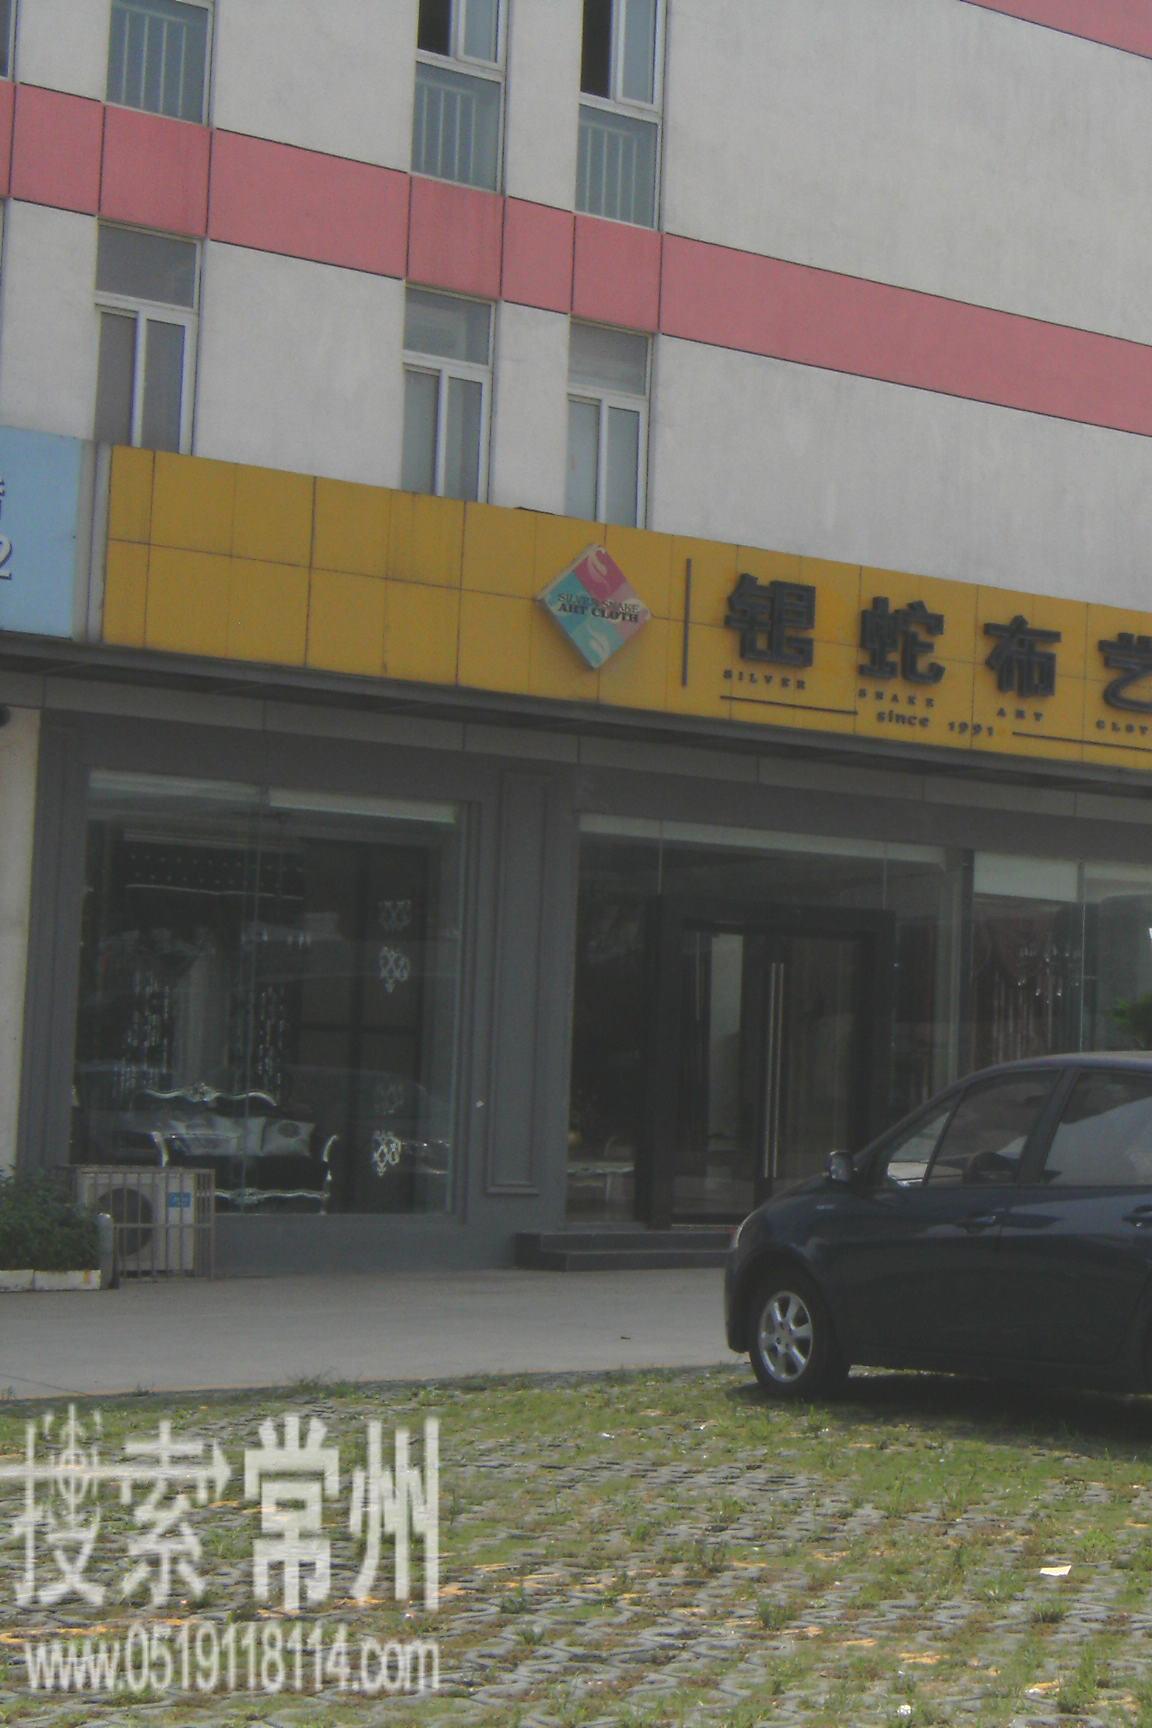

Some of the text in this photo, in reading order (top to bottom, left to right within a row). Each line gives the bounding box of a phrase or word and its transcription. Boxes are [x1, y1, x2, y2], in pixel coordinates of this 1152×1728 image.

[558, 602, 640, 622] ART CLOTH
[722, 669, 807, 690] SILVER
[858, 688, 935, 708] SNAKE
[997, 707, 1043, 722] ART
[876, 709, 995, 737] since 1991
